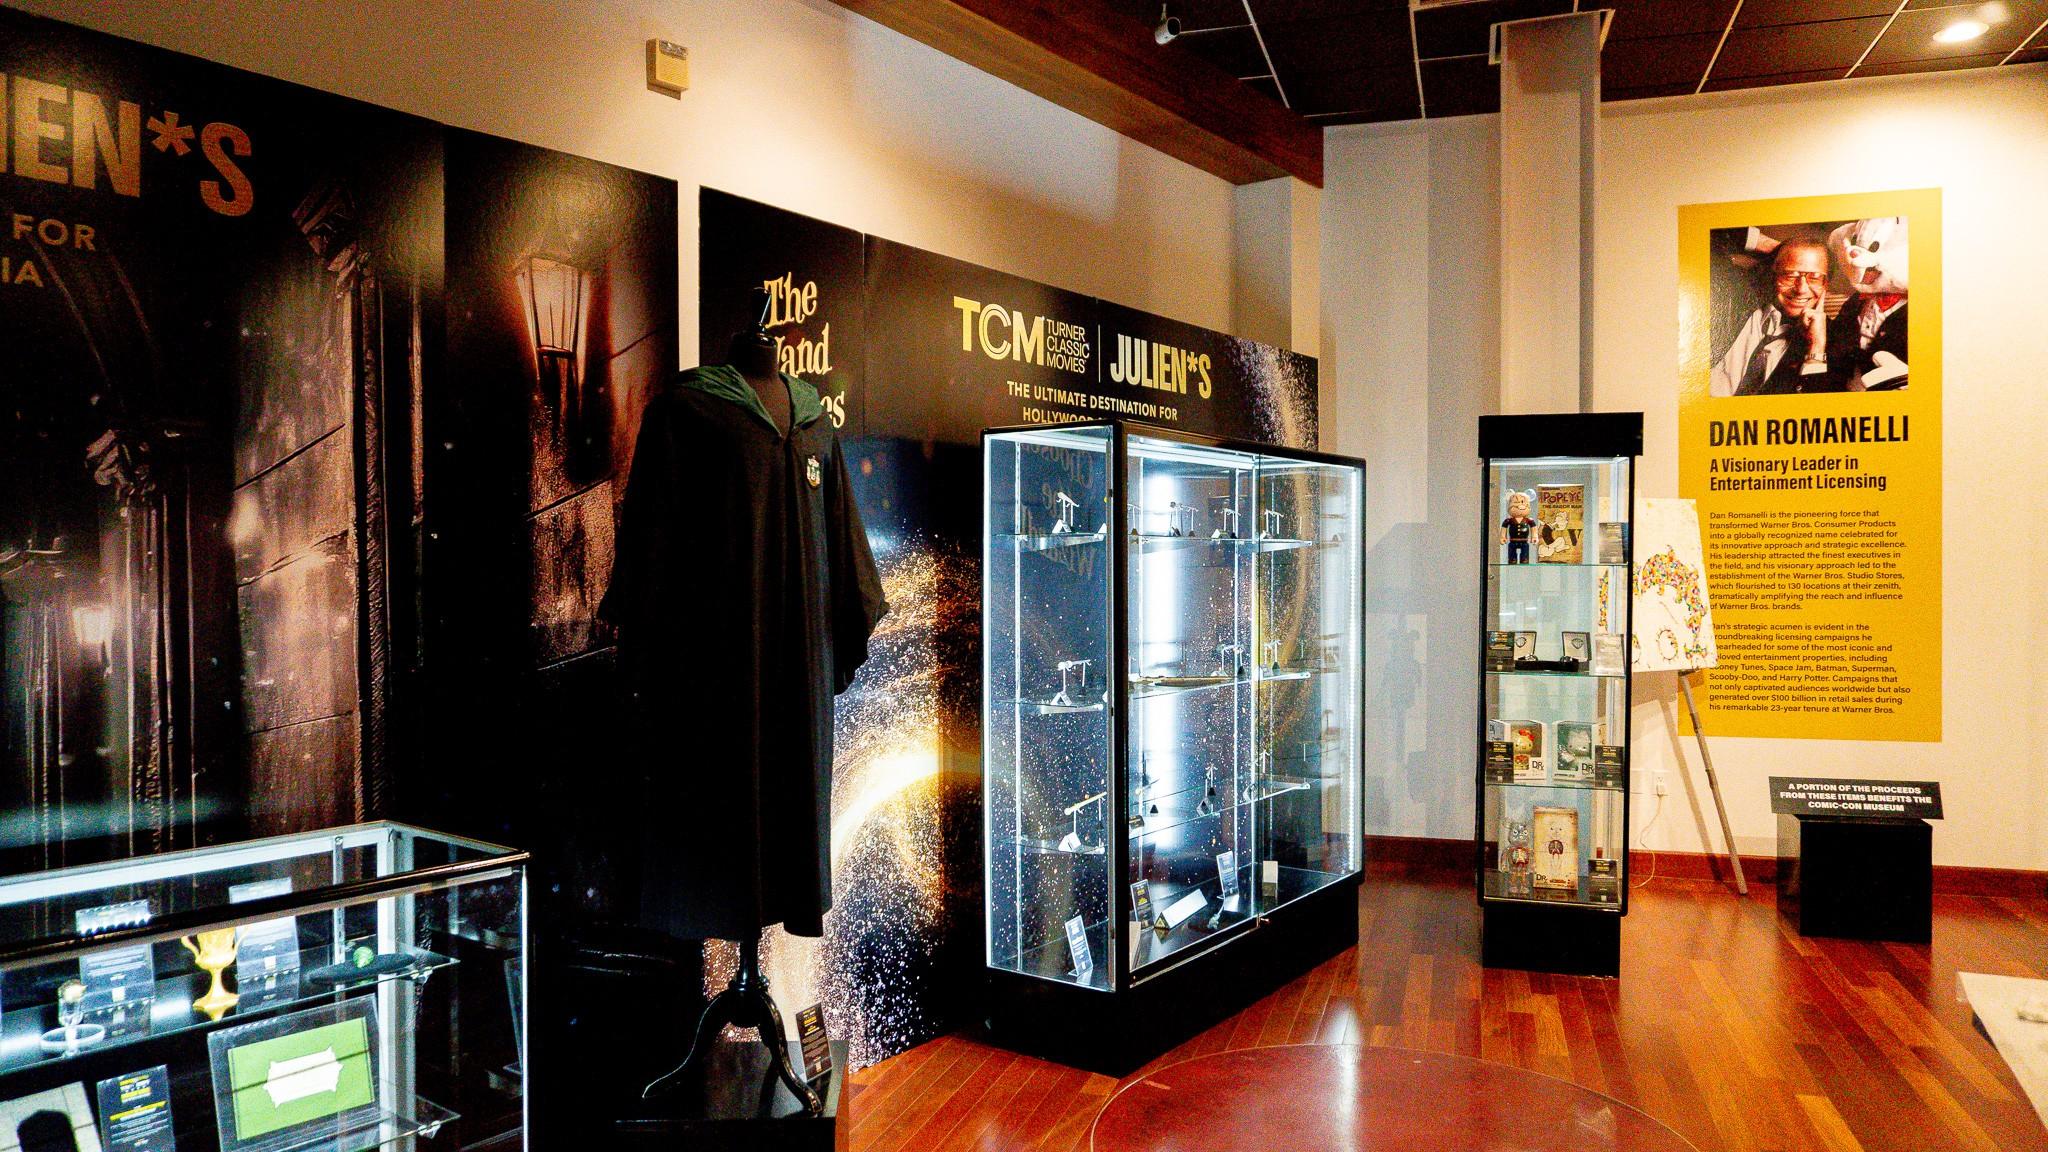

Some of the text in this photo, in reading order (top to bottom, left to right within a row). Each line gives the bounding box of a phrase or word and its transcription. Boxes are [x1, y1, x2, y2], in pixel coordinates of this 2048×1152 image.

[14, 213, 96, 250] FOR
[764, 272, 818, 328] The
[954, 296, 1044, 366] TCM
[1047, 318, 1086, 342] TURNER
[1046, 336, 1090, 359] CLASSIC
[1047, 352, 1086, 374] MOVIES
[1006, 380, 1178, 420] THE ULTIMATE DESTINATION FOR
[1710, 415, 1909, 447] DAN ROMANELLI
[1710, 455, 1858, 475] A Visionary Leader in
[1710, 474, 1886, 491] Entertainment Licensing
[1544, 492, 1581, 503] POPEYE
[1793, 510, 1837, 519] pioneering
[1733, 532, 1765, 540] globally
[1767, 531, 1812, 540] recognized
[1764, 542, 1802, 550] approach
[1822, 541, 1858, 550] strategic
[1724, 552, 1766, 561] leadership
[1724, 562, 1743, 571] field,
[1777, 562, 1814, 571] visionary
[1815, 562, 1855, 570] approach
[1875, 572, 1904, 580] Stores,
[1873, 583, 1901, 591] zenith,
[1709, 592, 1758, 601] dramatically
[1760, 592, 1803, 601] amplifying
[1733, 623, 1767, 632] strategic
[1775, 634, 1812, 642] licensing
[1814, 634, 1860, 642] campaigns
[1802, 654, 1846, 663] properties,
[1848, 655, 1887, 664] including
[1741, 664, 1896, 674] Tunes, Space Jam, Batman, Superman,
[1709, 673, 1759, 682] Scooby-Doo,
[1779, 674, 1802, 683] Harry
[1832, 675, 1879, 684] Campaigns
[1724, 684, 1741, 692] only
[1743, 684, 1785, 693] captivated
[1709, 693, 1749, 703] generated
[1771, 694, 1789, 703] $100
[1874, 696, 1902, 705] during
[1770, 704, 1800, 714] 23-year
[1872, 786, 1921, 794] PROCEEDS
[1808, 801, 1904, 812] COMIC-CON MUSEUM
